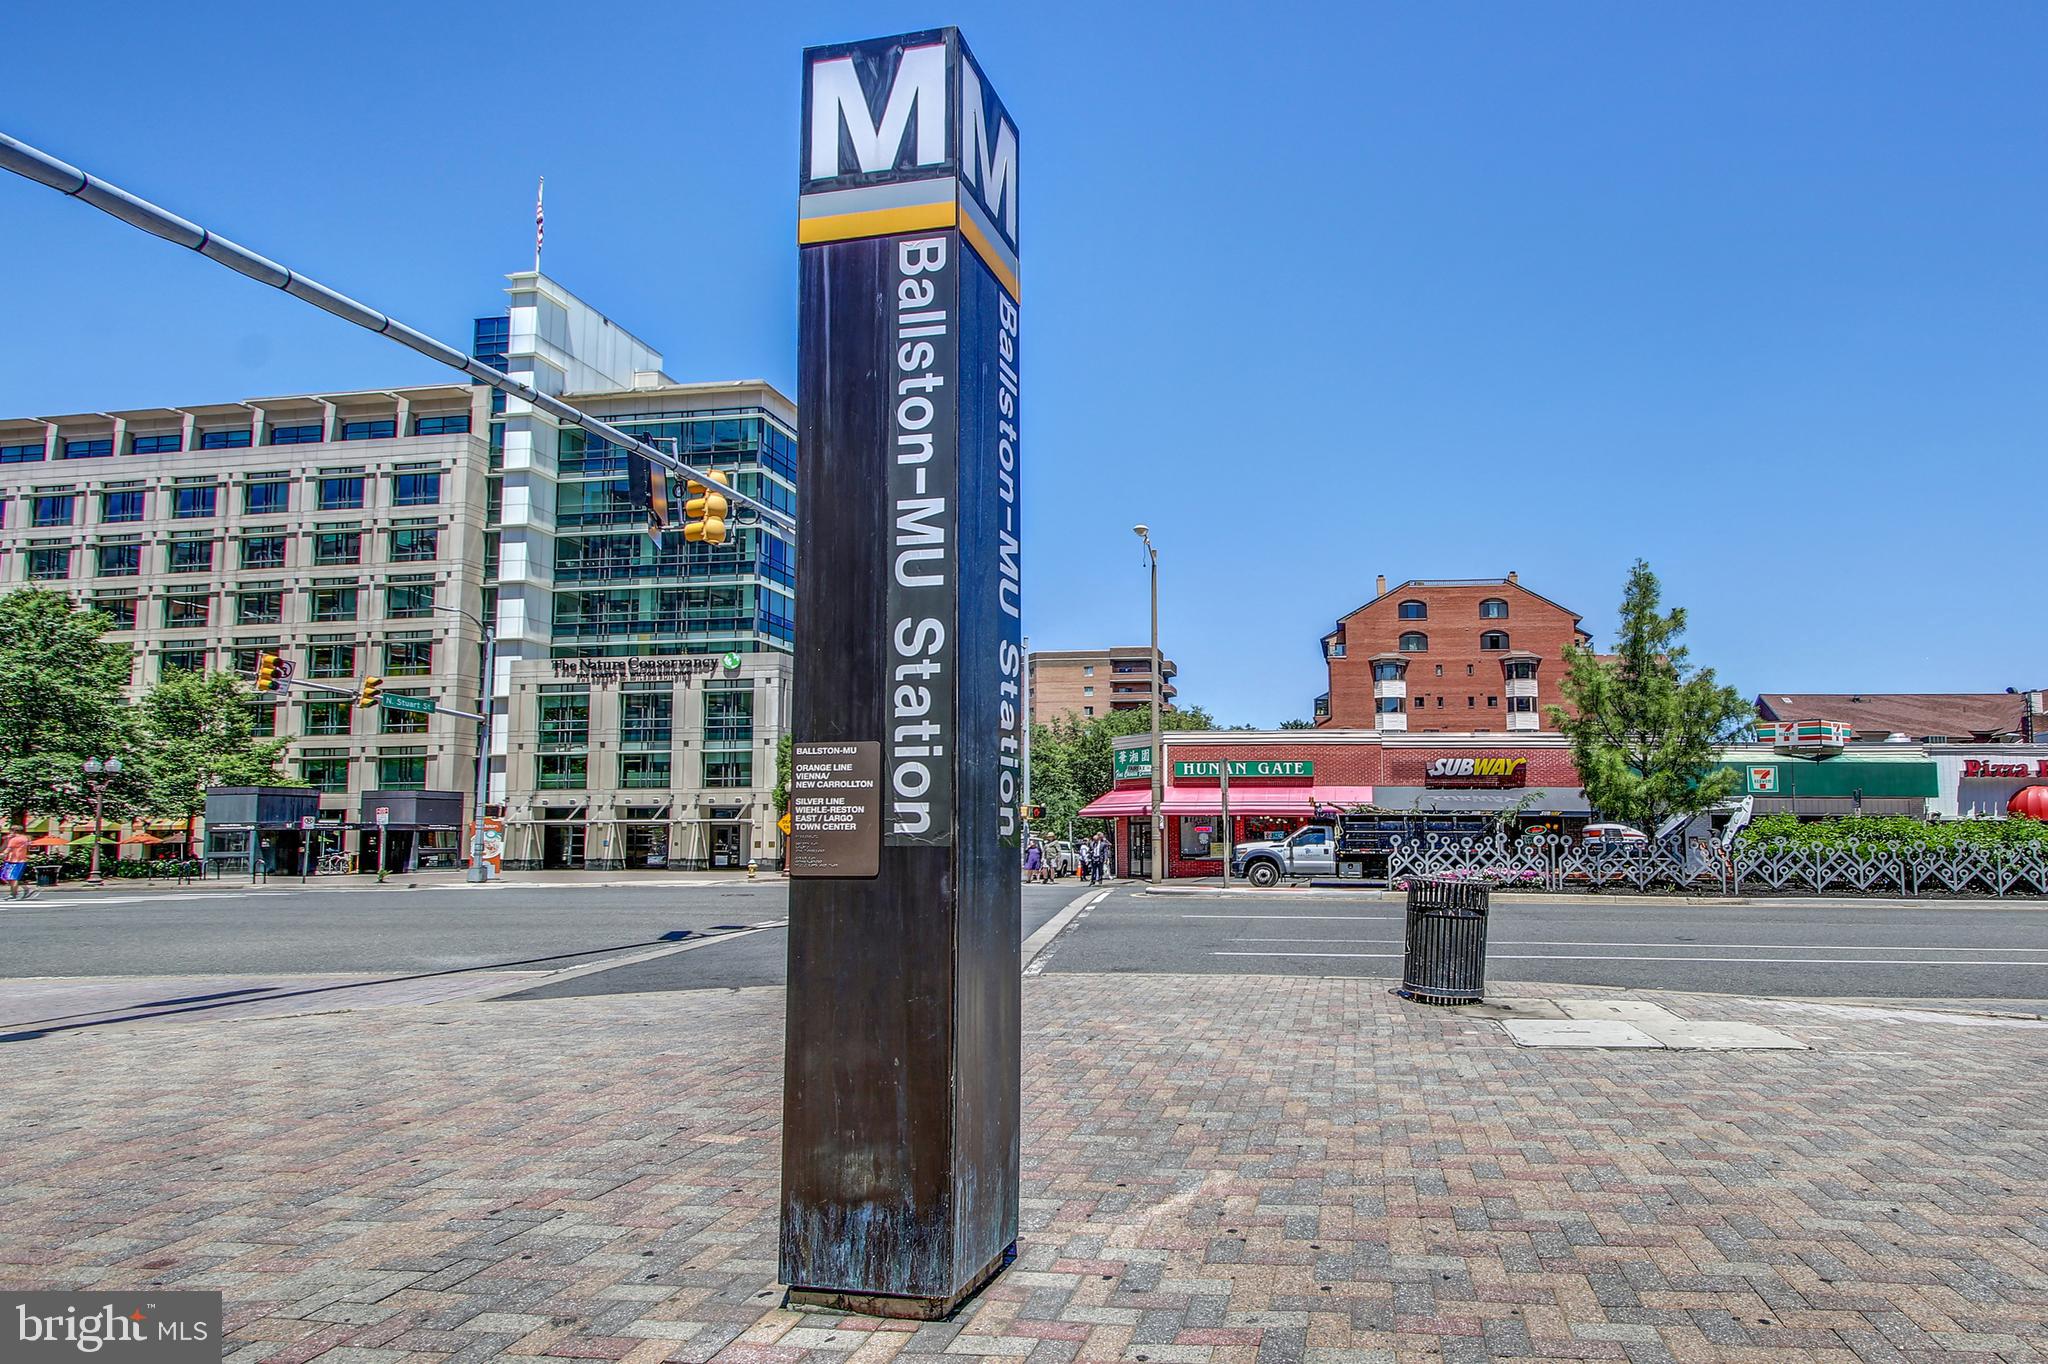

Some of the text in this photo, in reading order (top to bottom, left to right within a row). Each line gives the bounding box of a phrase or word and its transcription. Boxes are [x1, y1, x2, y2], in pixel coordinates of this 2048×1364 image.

[810, 43, 946, 180] M
[962, 54, 1017, 250] M
[893, 236, 947, 834] Ballston-MU Station
[999, 290, 1020, 837] Ballston-MU Station
[551, 657, 719, 672] The Nature Conservancy
[396, 698, 420, 709] Stuart
[796, 747, 857, 755] BALLSTON-MU
[796, 763, 853, 772] ORANGE LINE
[1183, 762, 1304, 775] HUNAN GATE
[1428, 757, 1527, 776] SUBWAY
[1963, 759, 2031, 777] Pizza
[796, 772, 830, 780] VIENNA/
[816, 780, 874, 788] CARROLLTON
[795, 797, 845, 806] SILVER LINE
[795, 806, 865, 814] WIEHLE-RESTON
[795, 814, 817, 823] EAST
[823, 814, 853, 822] LARGO
[795, 823, 857, 831] TOWN CENTER
